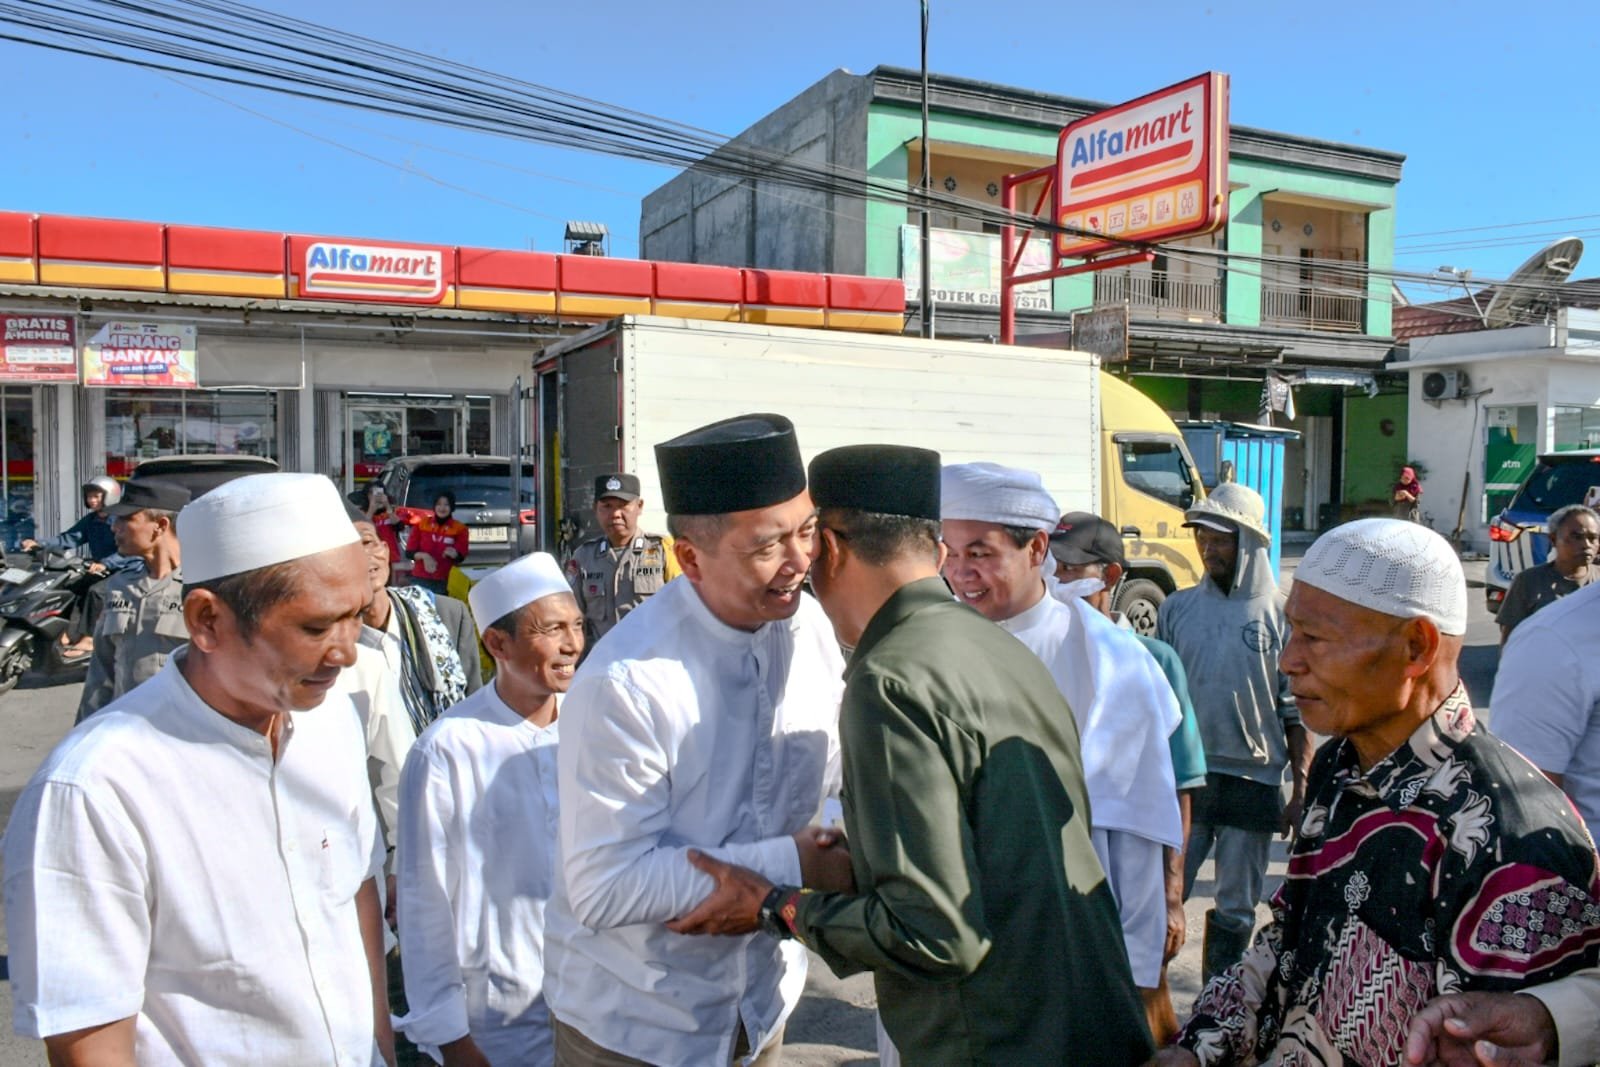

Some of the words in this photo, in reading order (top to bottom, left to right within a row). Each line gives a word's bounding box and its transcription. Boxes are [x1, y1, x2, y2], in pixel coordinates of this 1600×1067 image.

[1071, 102, 1193, 168] Alfamart
[308, 246, 436, 275] Alfamart
[979, 292, 1048, 309] CAYSTA
[5, 318, 67, 330] GRATIS
[101, 348, 178, 364] BANYAK
[1502, 459, 1520, 468] atm
